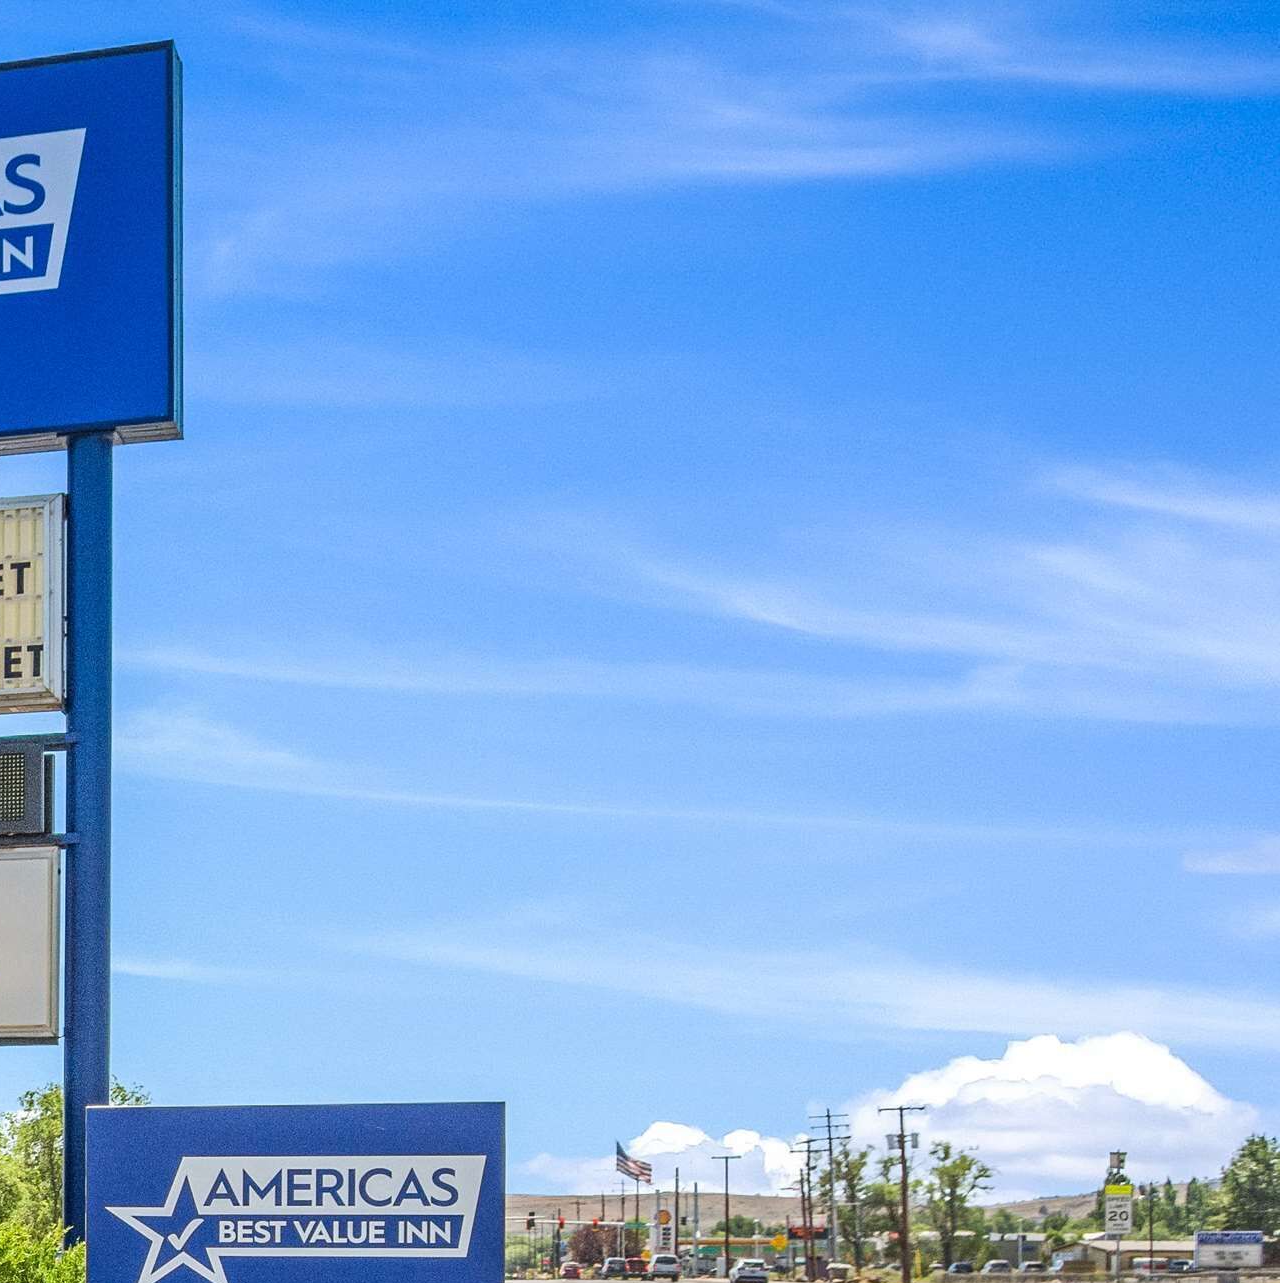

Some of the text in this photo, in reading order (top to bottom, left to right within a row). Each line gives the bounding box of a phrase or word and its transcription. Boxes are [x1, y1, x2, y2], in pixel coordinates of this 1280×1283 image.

[203, 1167, 459, 1207] AMERICAS
[1108, 1210, 1129, 1221] 20
[219, 1220, 451, 1244] BEST VALUE INN
